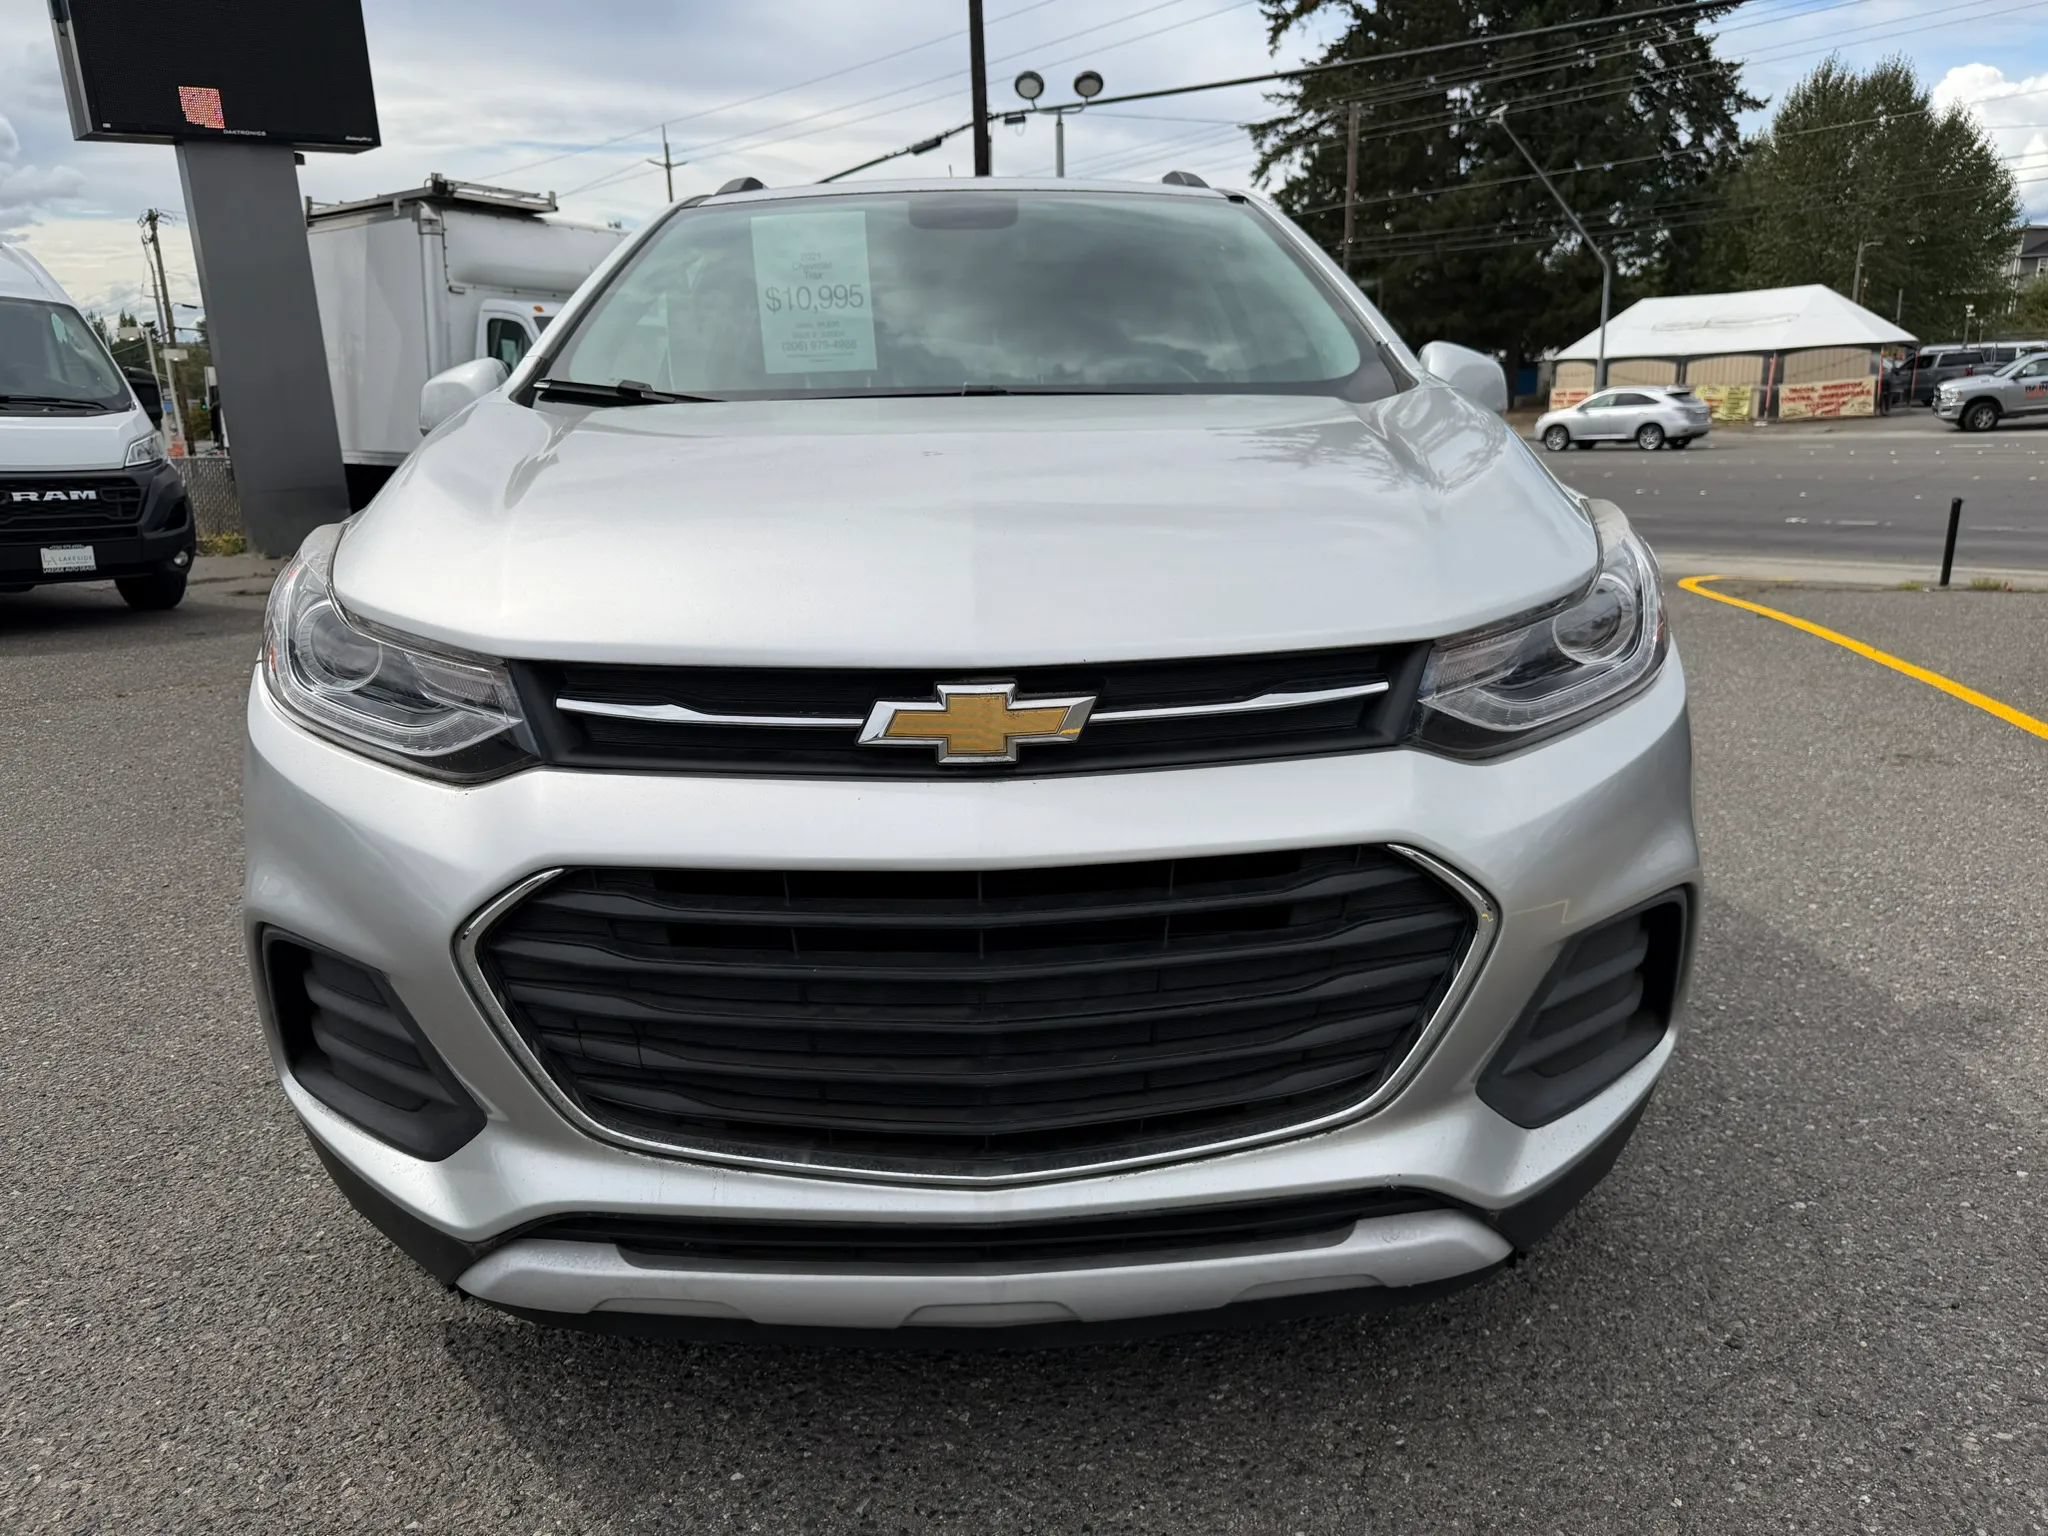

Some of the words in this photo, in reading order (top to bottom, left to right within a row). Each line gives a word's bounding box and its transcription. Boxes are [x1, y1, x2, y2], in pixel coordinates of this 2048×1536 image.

[223, 129, 267, 137] DAKTRONICS
[765, 284, 865, 314] $10,995
[11, 490, 96, 502] RAM
